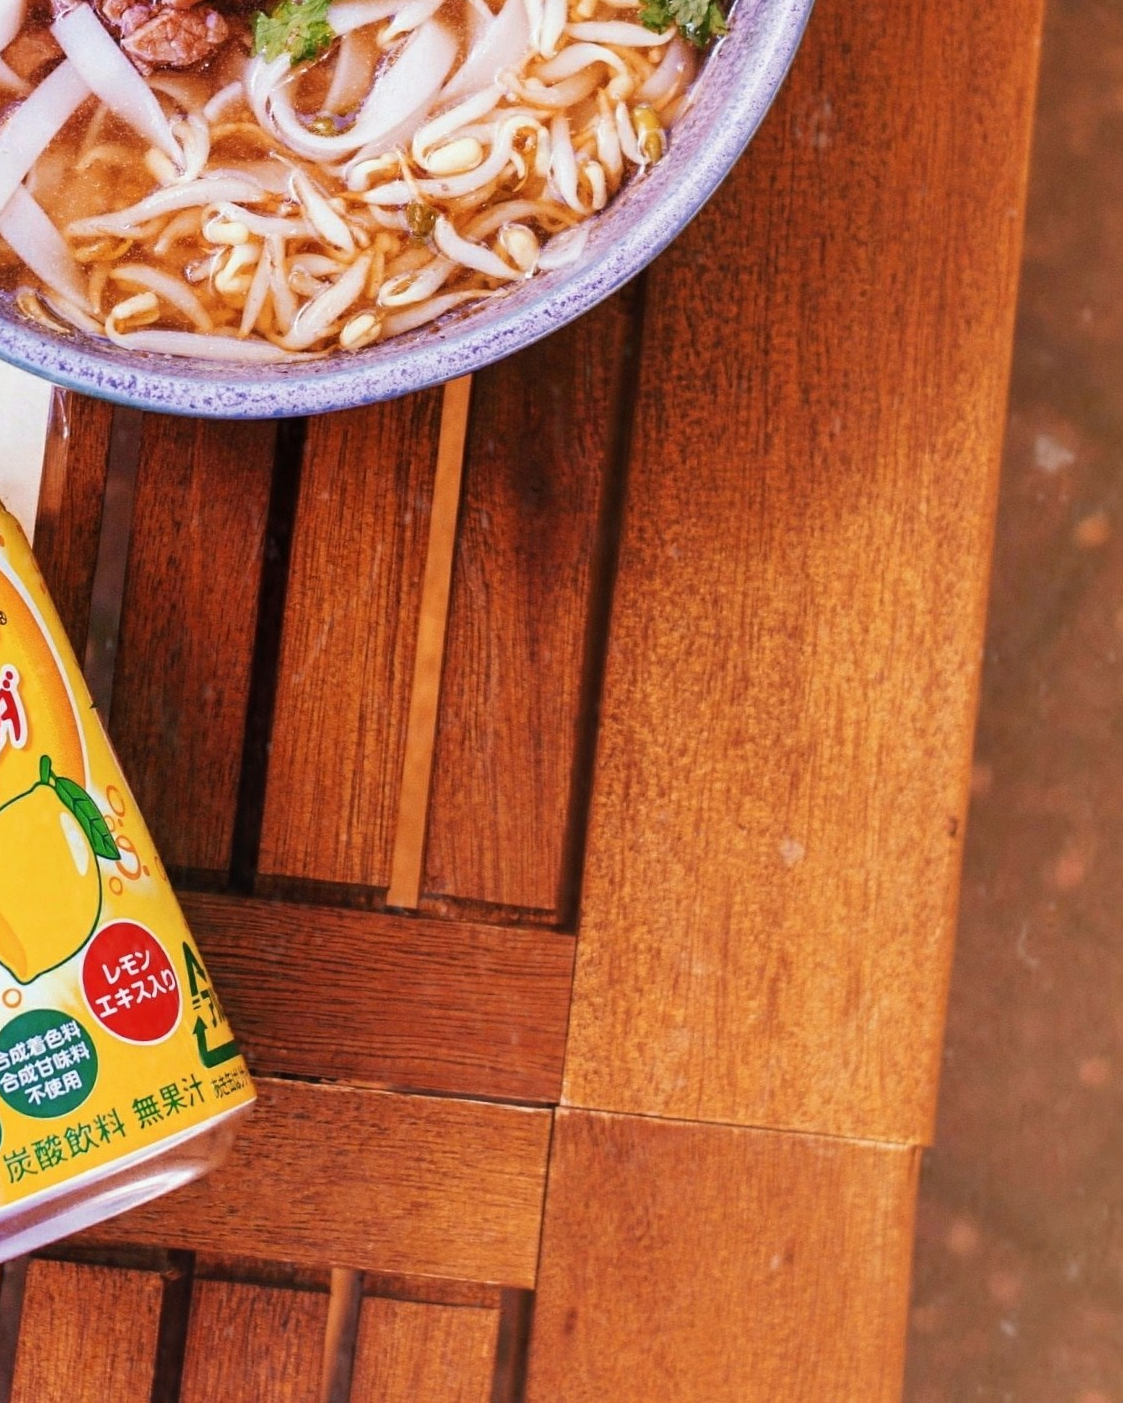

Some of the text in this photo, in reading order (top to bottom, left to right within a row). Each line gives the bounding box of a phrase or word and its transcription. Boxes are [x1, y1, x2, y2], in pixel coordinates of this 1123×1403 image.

[102, 949, 153, 986] レモン
[94, 968, 179, 1019] エキス入り
[0, 1041, 91, 1094] 合成甘味料
[24, 1069, 84, 1107] 不使用
[2, 1073, 205, 1184] 炭酸飲料 無果汁
